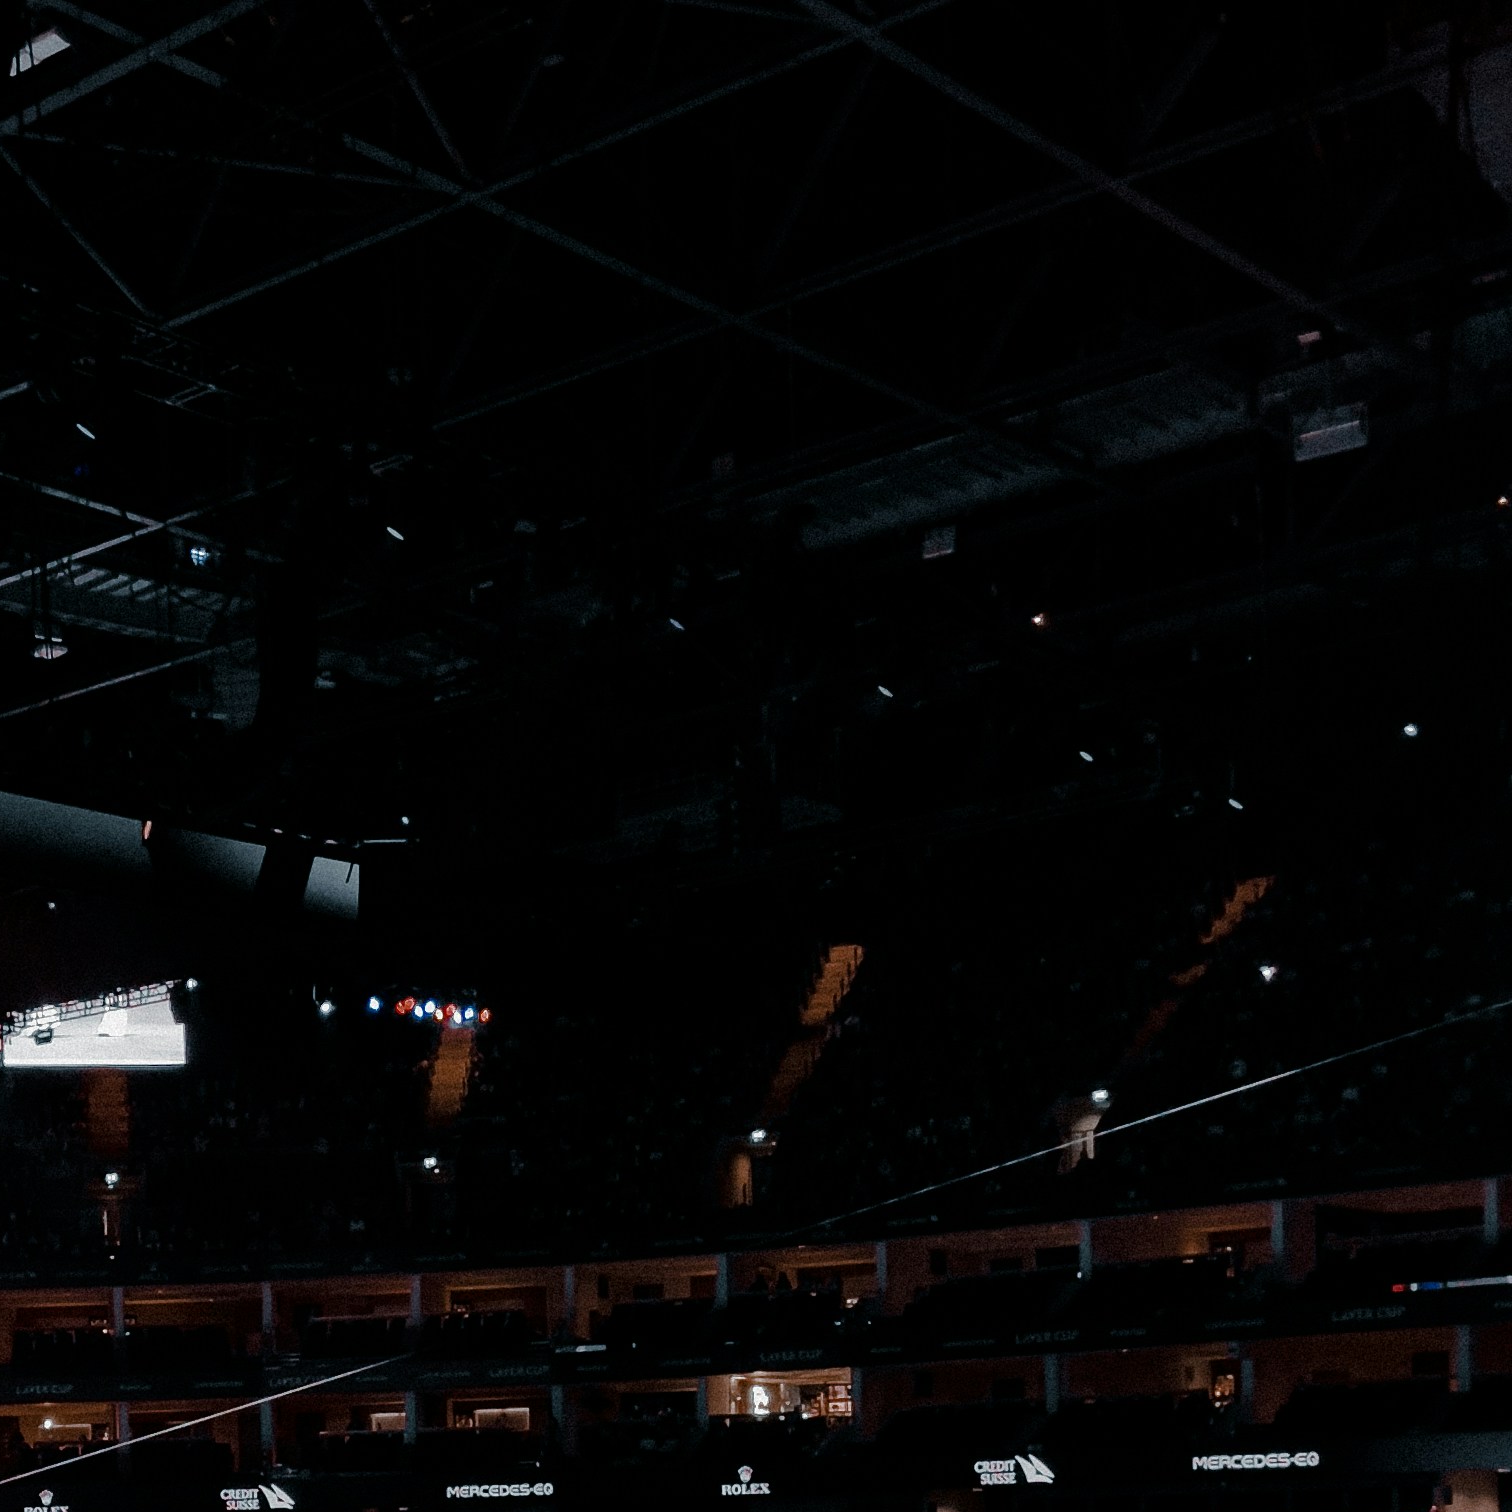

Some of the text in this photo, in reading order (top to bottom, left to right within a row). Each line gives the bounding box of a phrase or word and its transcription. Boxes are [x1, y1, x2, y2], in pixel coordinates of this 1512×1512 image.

[973, 1459, 1017, 1474] CREDIT
[1191, 1451, 1320, 1470] MERCEDES-EQ
[979, 1472, 1018, 1486] SUISSE
[219, 1487, 260, 1500] CREDIT
[445, 1482, 555, 1498] MERCEDES-EQ
[721, 1482, 771, 1497] ROLEX
[225, 1499, 261, 1511] SUISSE
